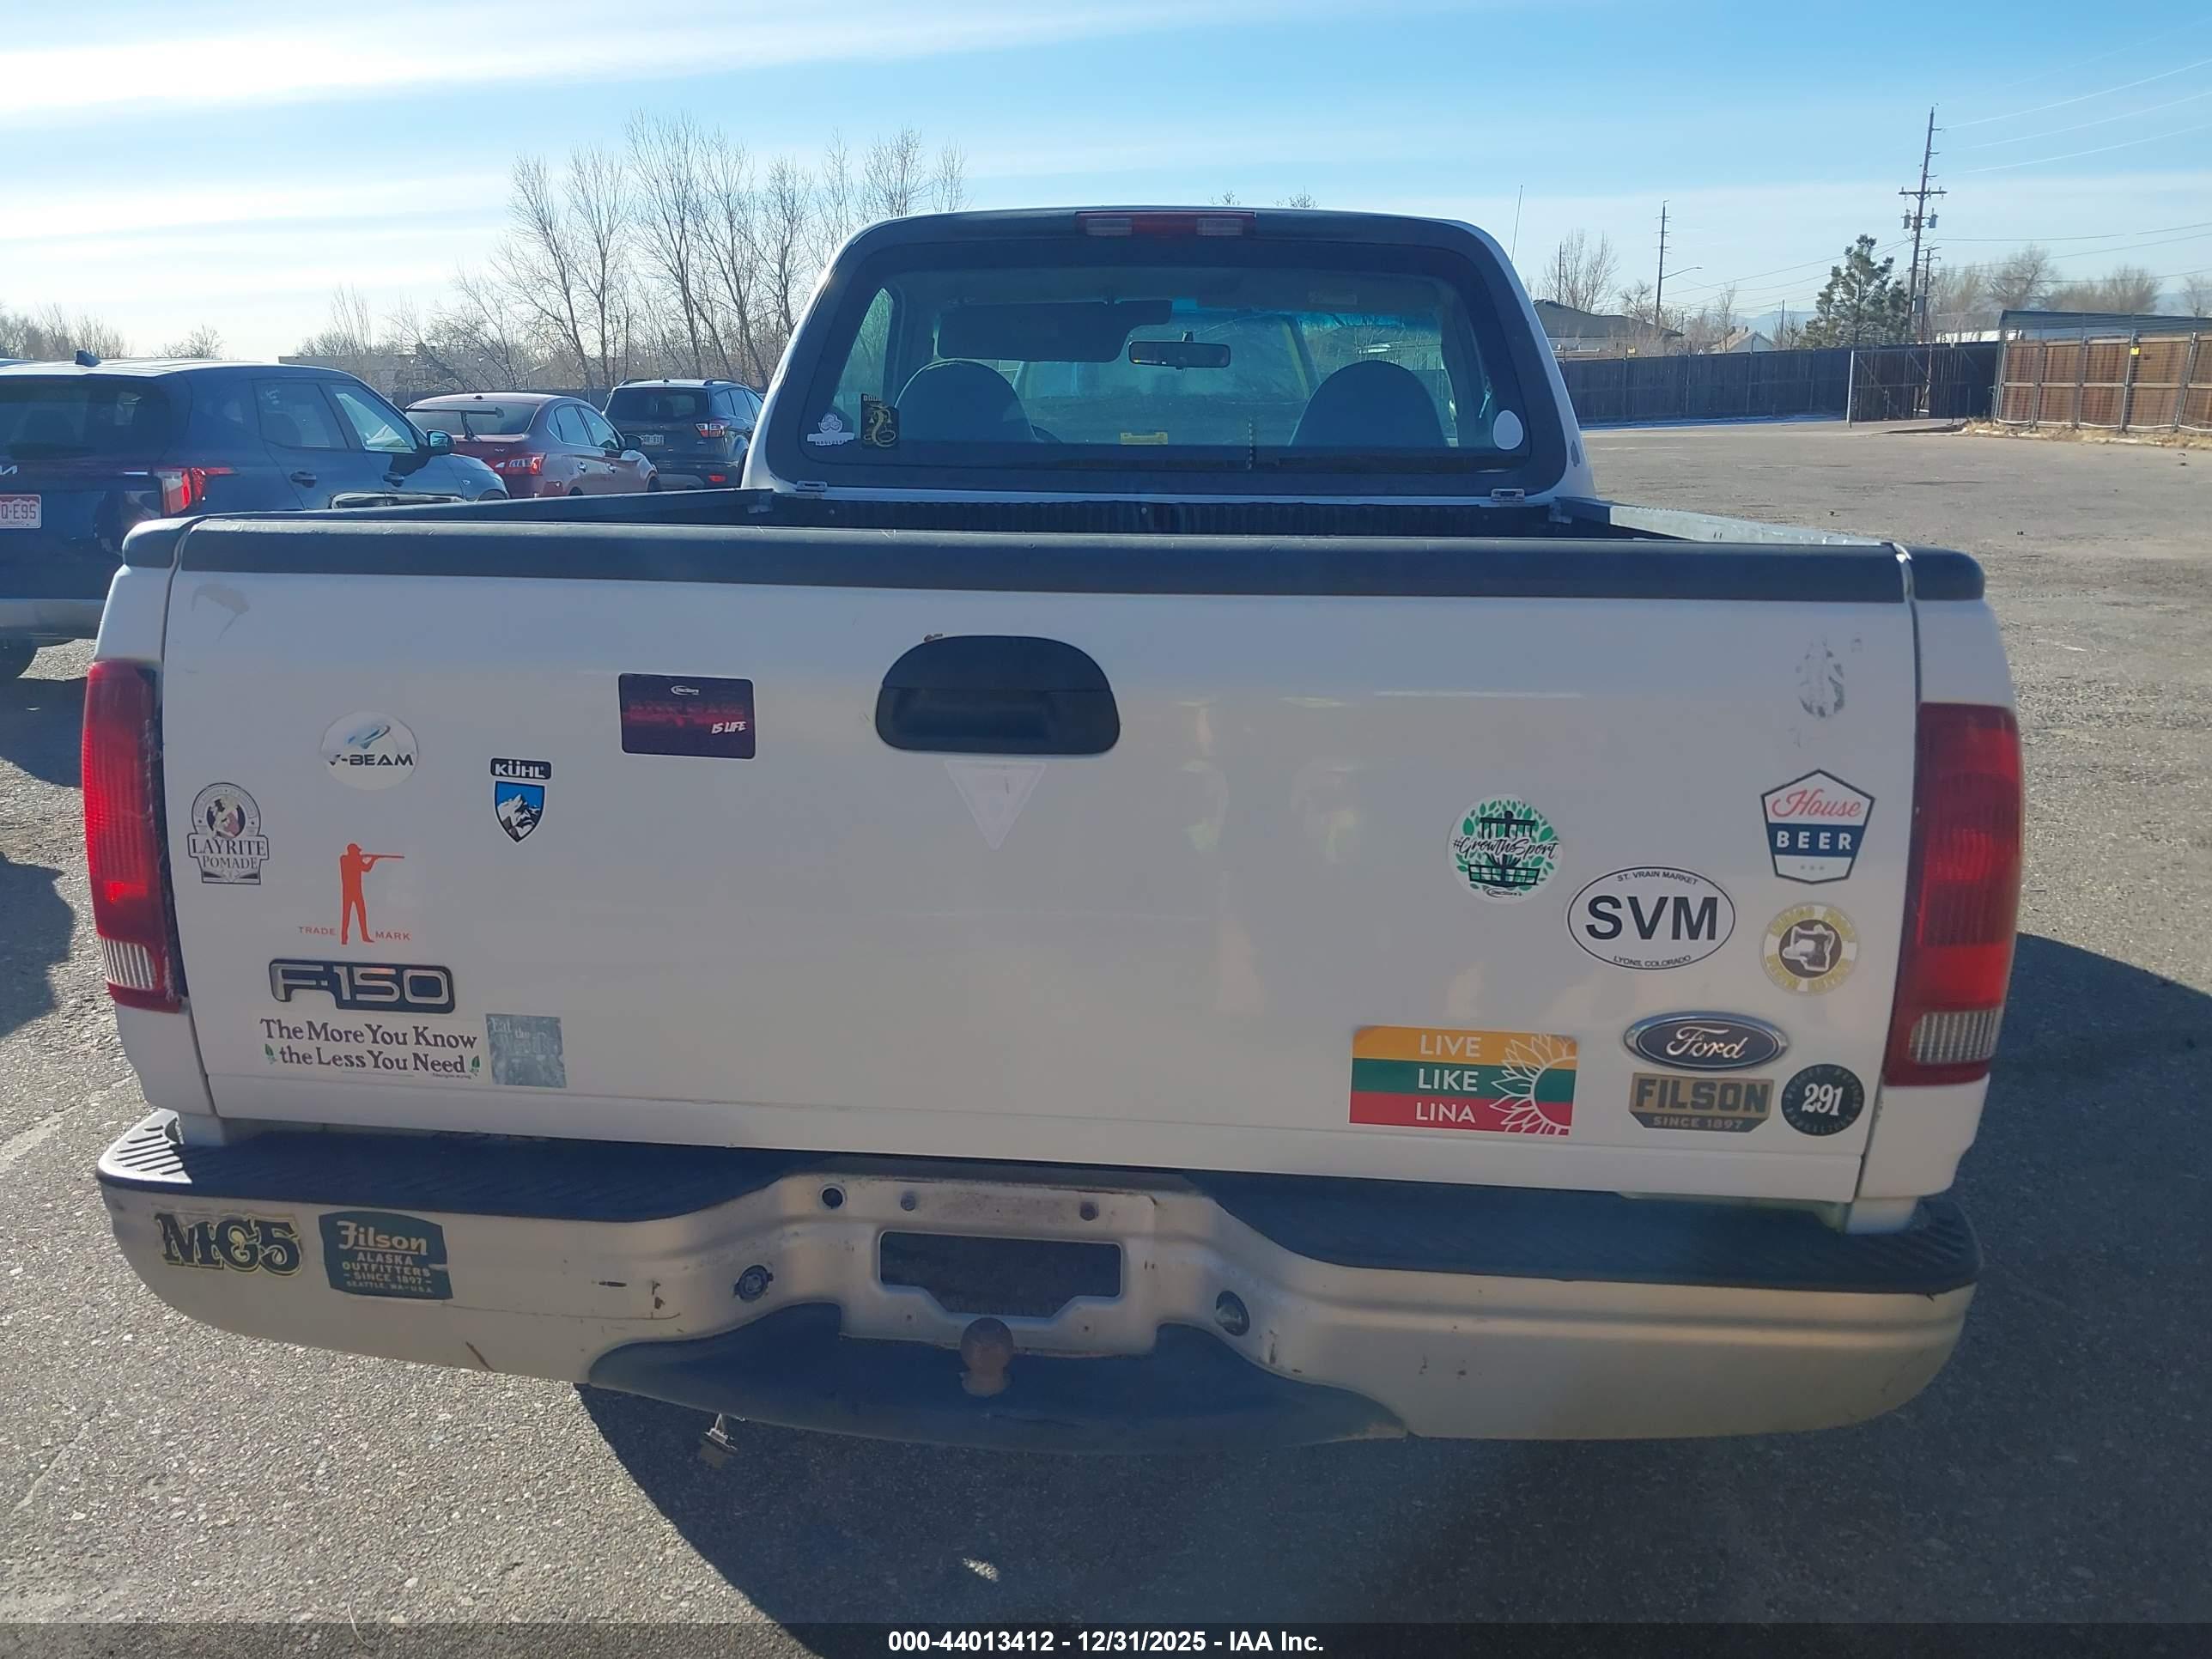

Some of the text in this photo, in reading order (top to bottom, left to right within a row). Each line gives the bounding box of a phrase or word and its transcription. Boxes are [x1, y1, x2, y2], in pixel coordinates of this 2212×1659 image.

[725, 721, 746, 732] LIFE
[495, 760, 546, 779] KÜHL
[1771, 788, 1862, 817] House
[191, 838, 266, 856] LAYRITE
[1776, 830, 1851, 850] BEER
[203, 855, 258, 869] POMADE
[1662, 872, 1698, 885] MARKET
[1585, 895, 1718, 940] SVM
[298, 926, 411, 941] TRADE MARK
[1644, 955, 1692, 968] COLORADO
[270, 963, 449, 1005] F-150
[259, 1018, 304, 1041] The
[306, 1020, 365, 1044] More
[364, 1023, 408, 1046] You
[412, 1025, 477, 1049] Know
[1666, 1026, 1748, 1060] Ford
[1420, 1035, 1481, 1058] LIVE
[279, 1044, 465, 1073] the Less You Need
[1418, 1068, 1480, 1092] LIKE
[1636, 1079, 1769, 1113] FILSON
[1802, 1084, 1843, 1116] 291
[1416, 1103, 1476, 1123] LINA
[1653, 1117, 1743, 1129] SINCE 1897
[337, 1220, 428, 1256] Filson
[356, 1251, 413, 1266] ALASKA
[343, 1261, 431, 1278] OUTFITTERS
[353, 1272, 392, 1283] SINCE
